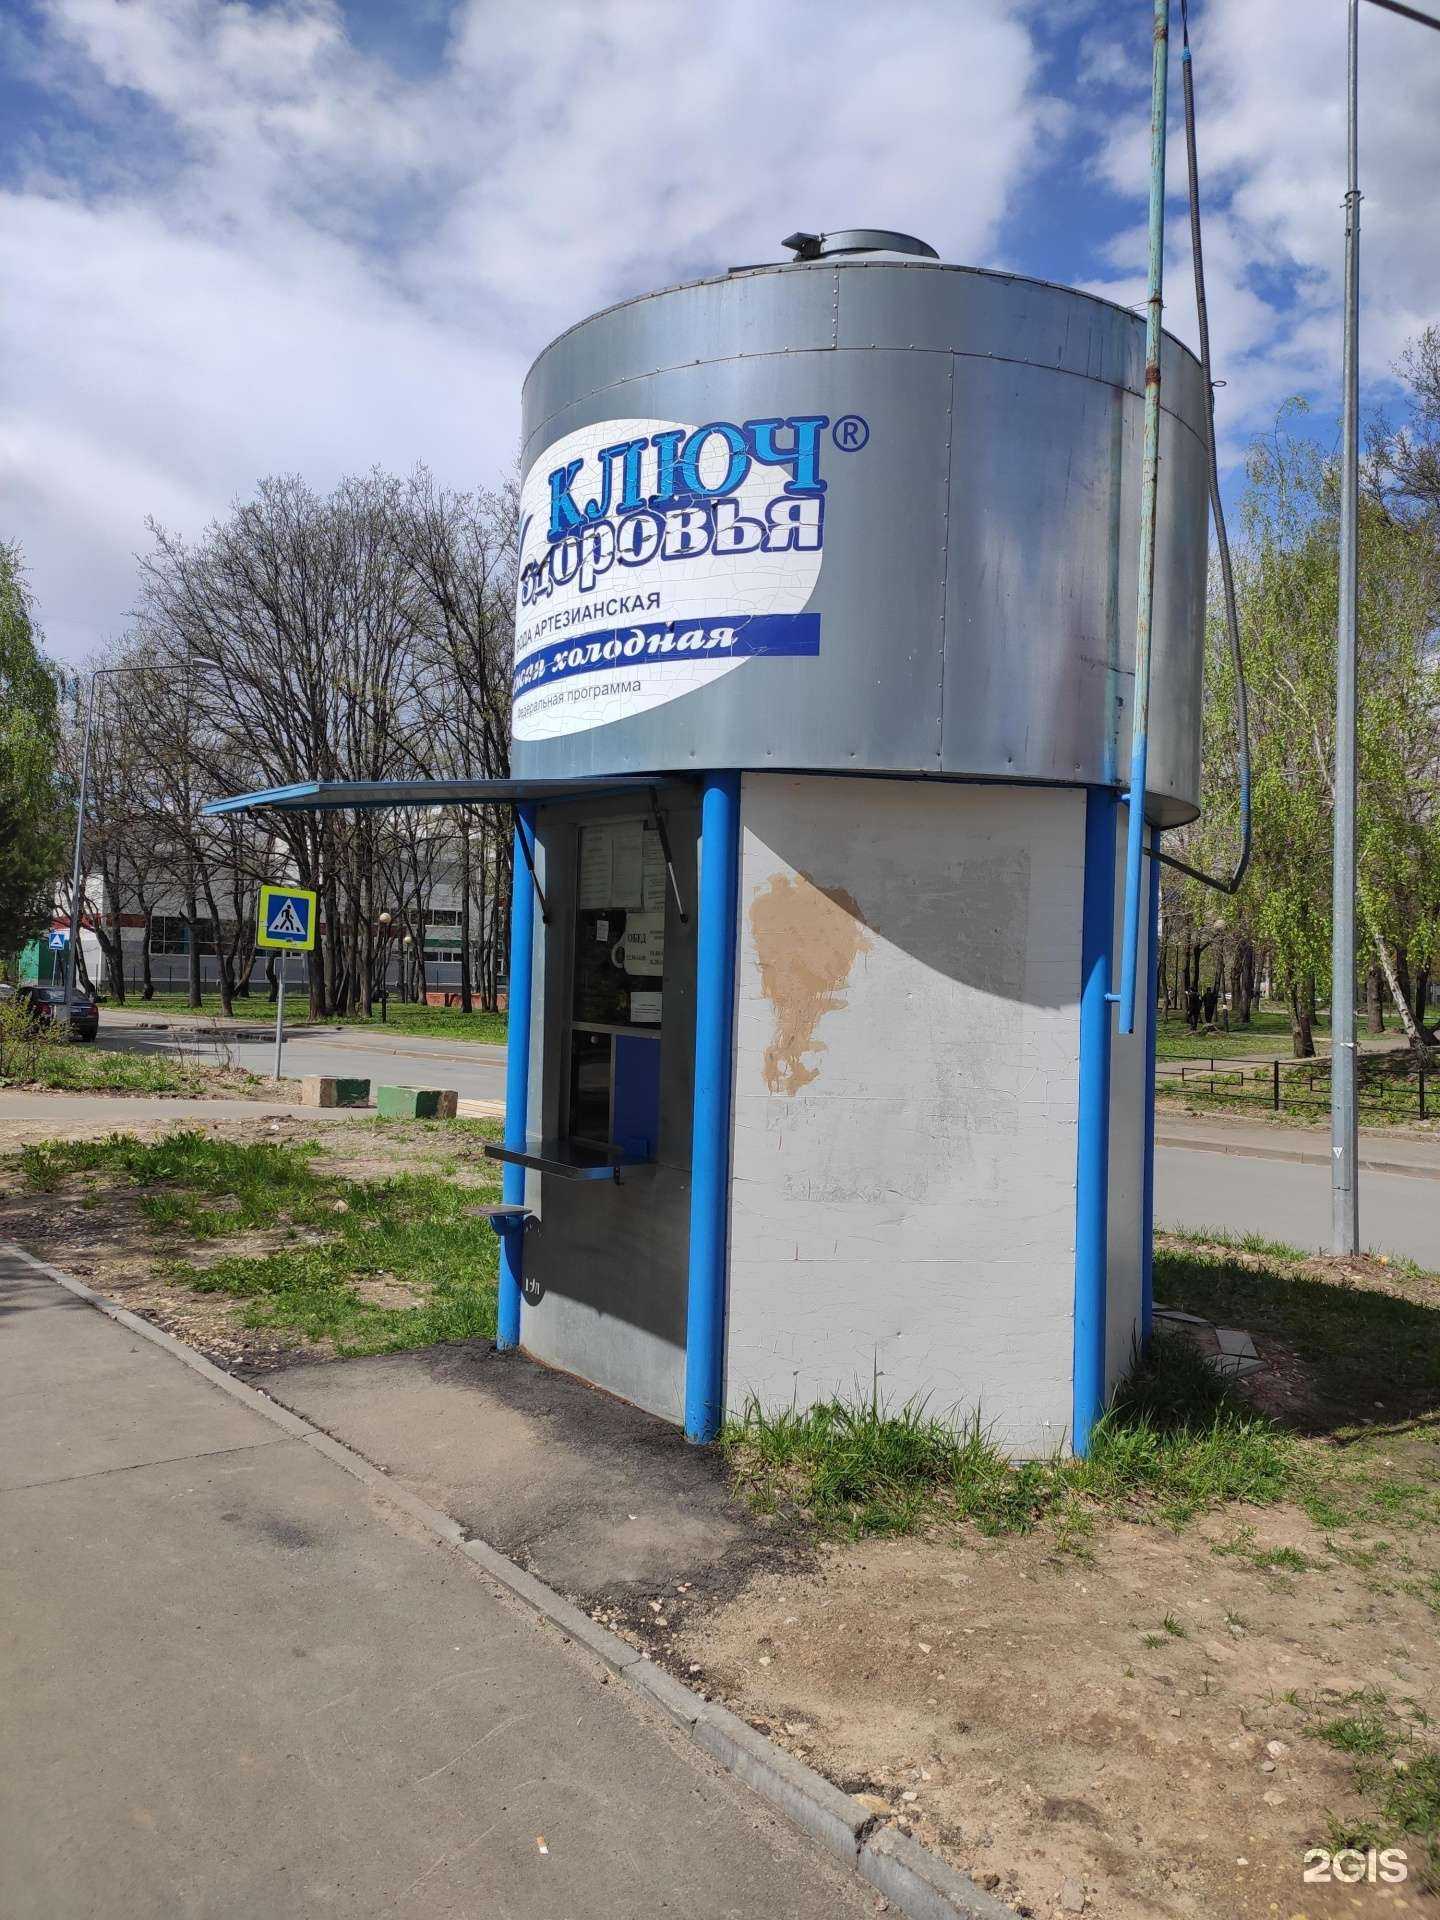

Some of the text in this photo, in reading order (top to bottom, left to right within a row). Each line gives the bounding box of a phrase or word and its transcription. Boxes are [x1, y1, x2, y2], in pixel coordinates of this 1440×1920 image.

[547, 415, 831, 537] КЛЮЧ
[534, 591, 661, 639] АРТЕЗИАНСКАЯ
[551, 625, 740, 673] холодная
[567, 680, 642, 705] программа
